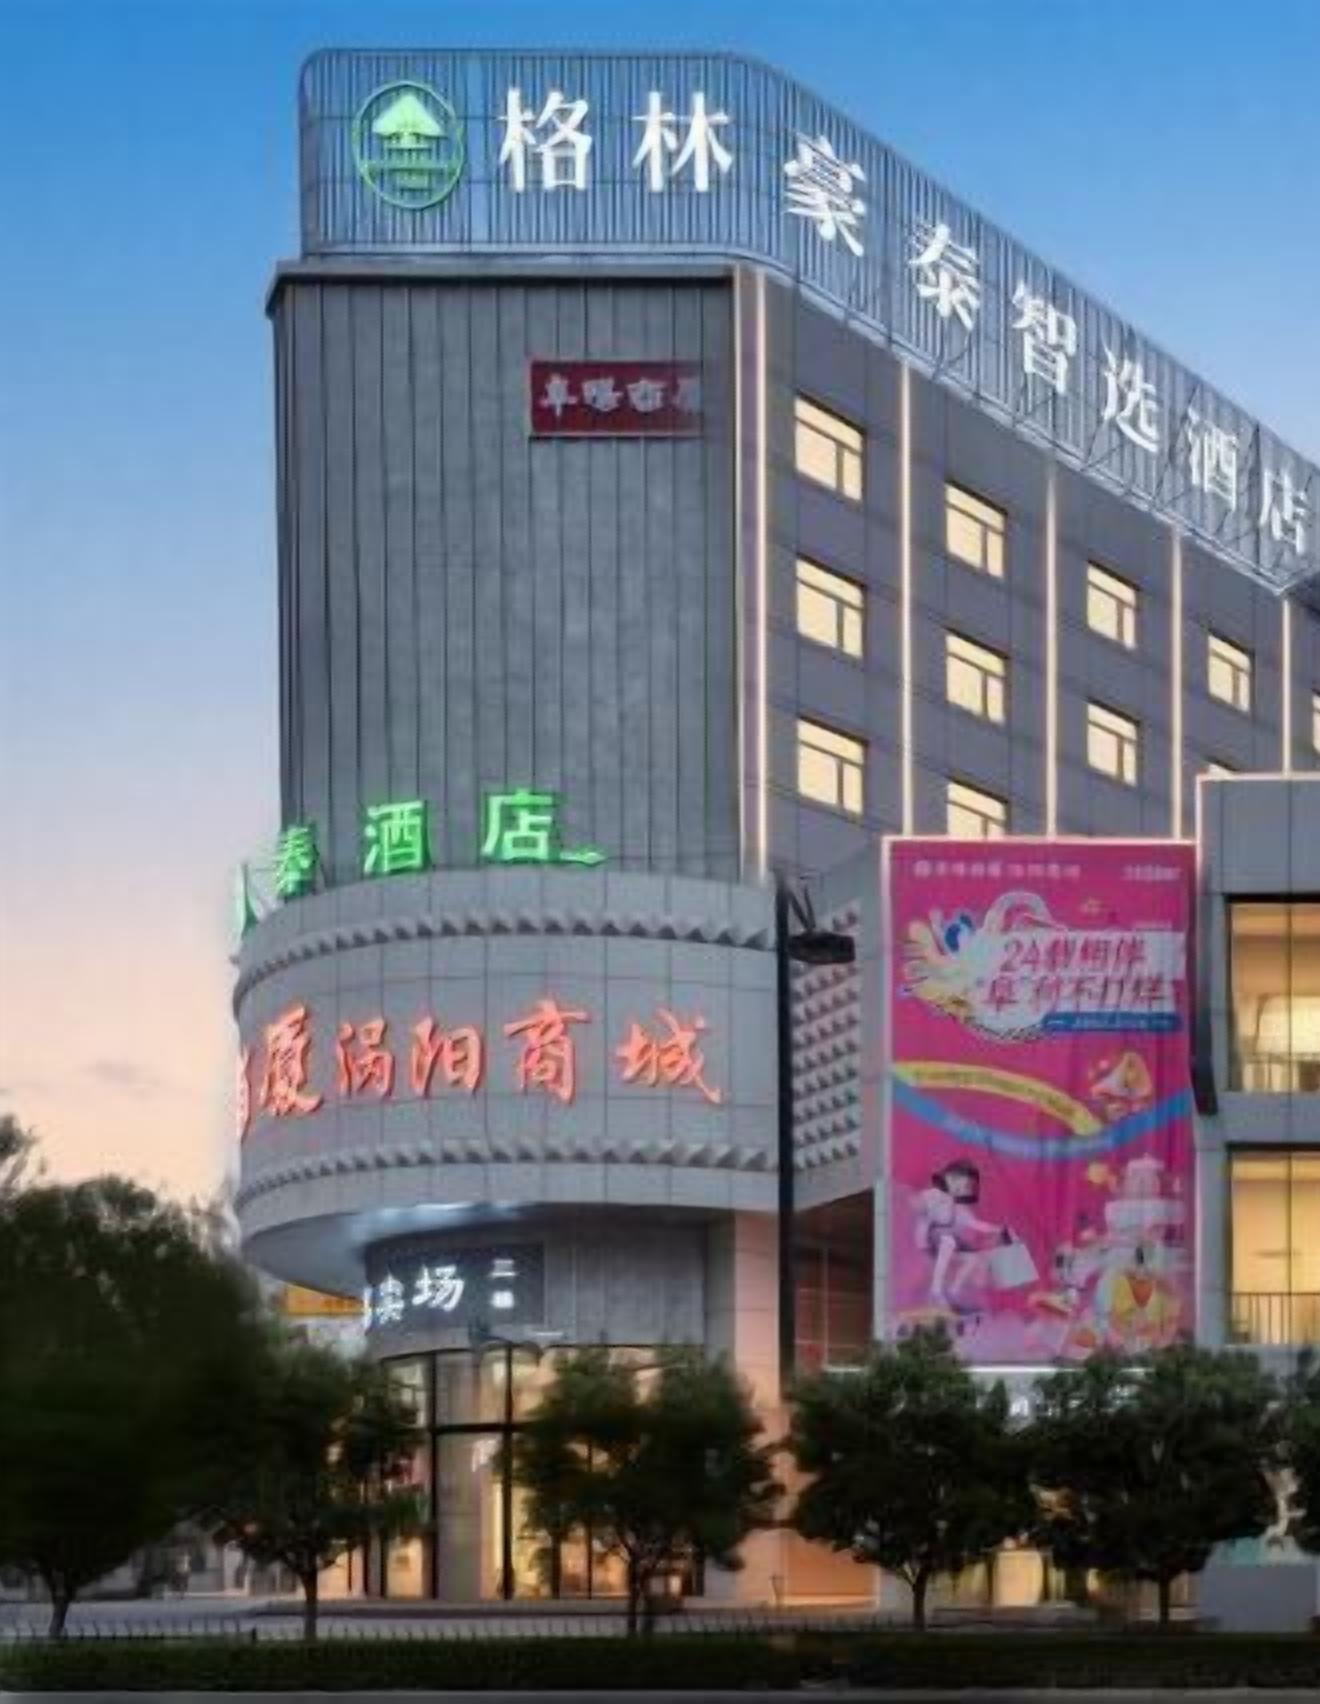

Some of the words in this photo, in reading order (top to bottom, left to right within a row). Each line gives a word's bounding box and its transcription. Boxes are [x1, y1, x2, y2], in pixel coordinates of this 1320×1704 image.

[497, 87, 1309, 553] 格林豪泰智选酒店
[234, 995, 721, 1142] 厦涡阳商城
